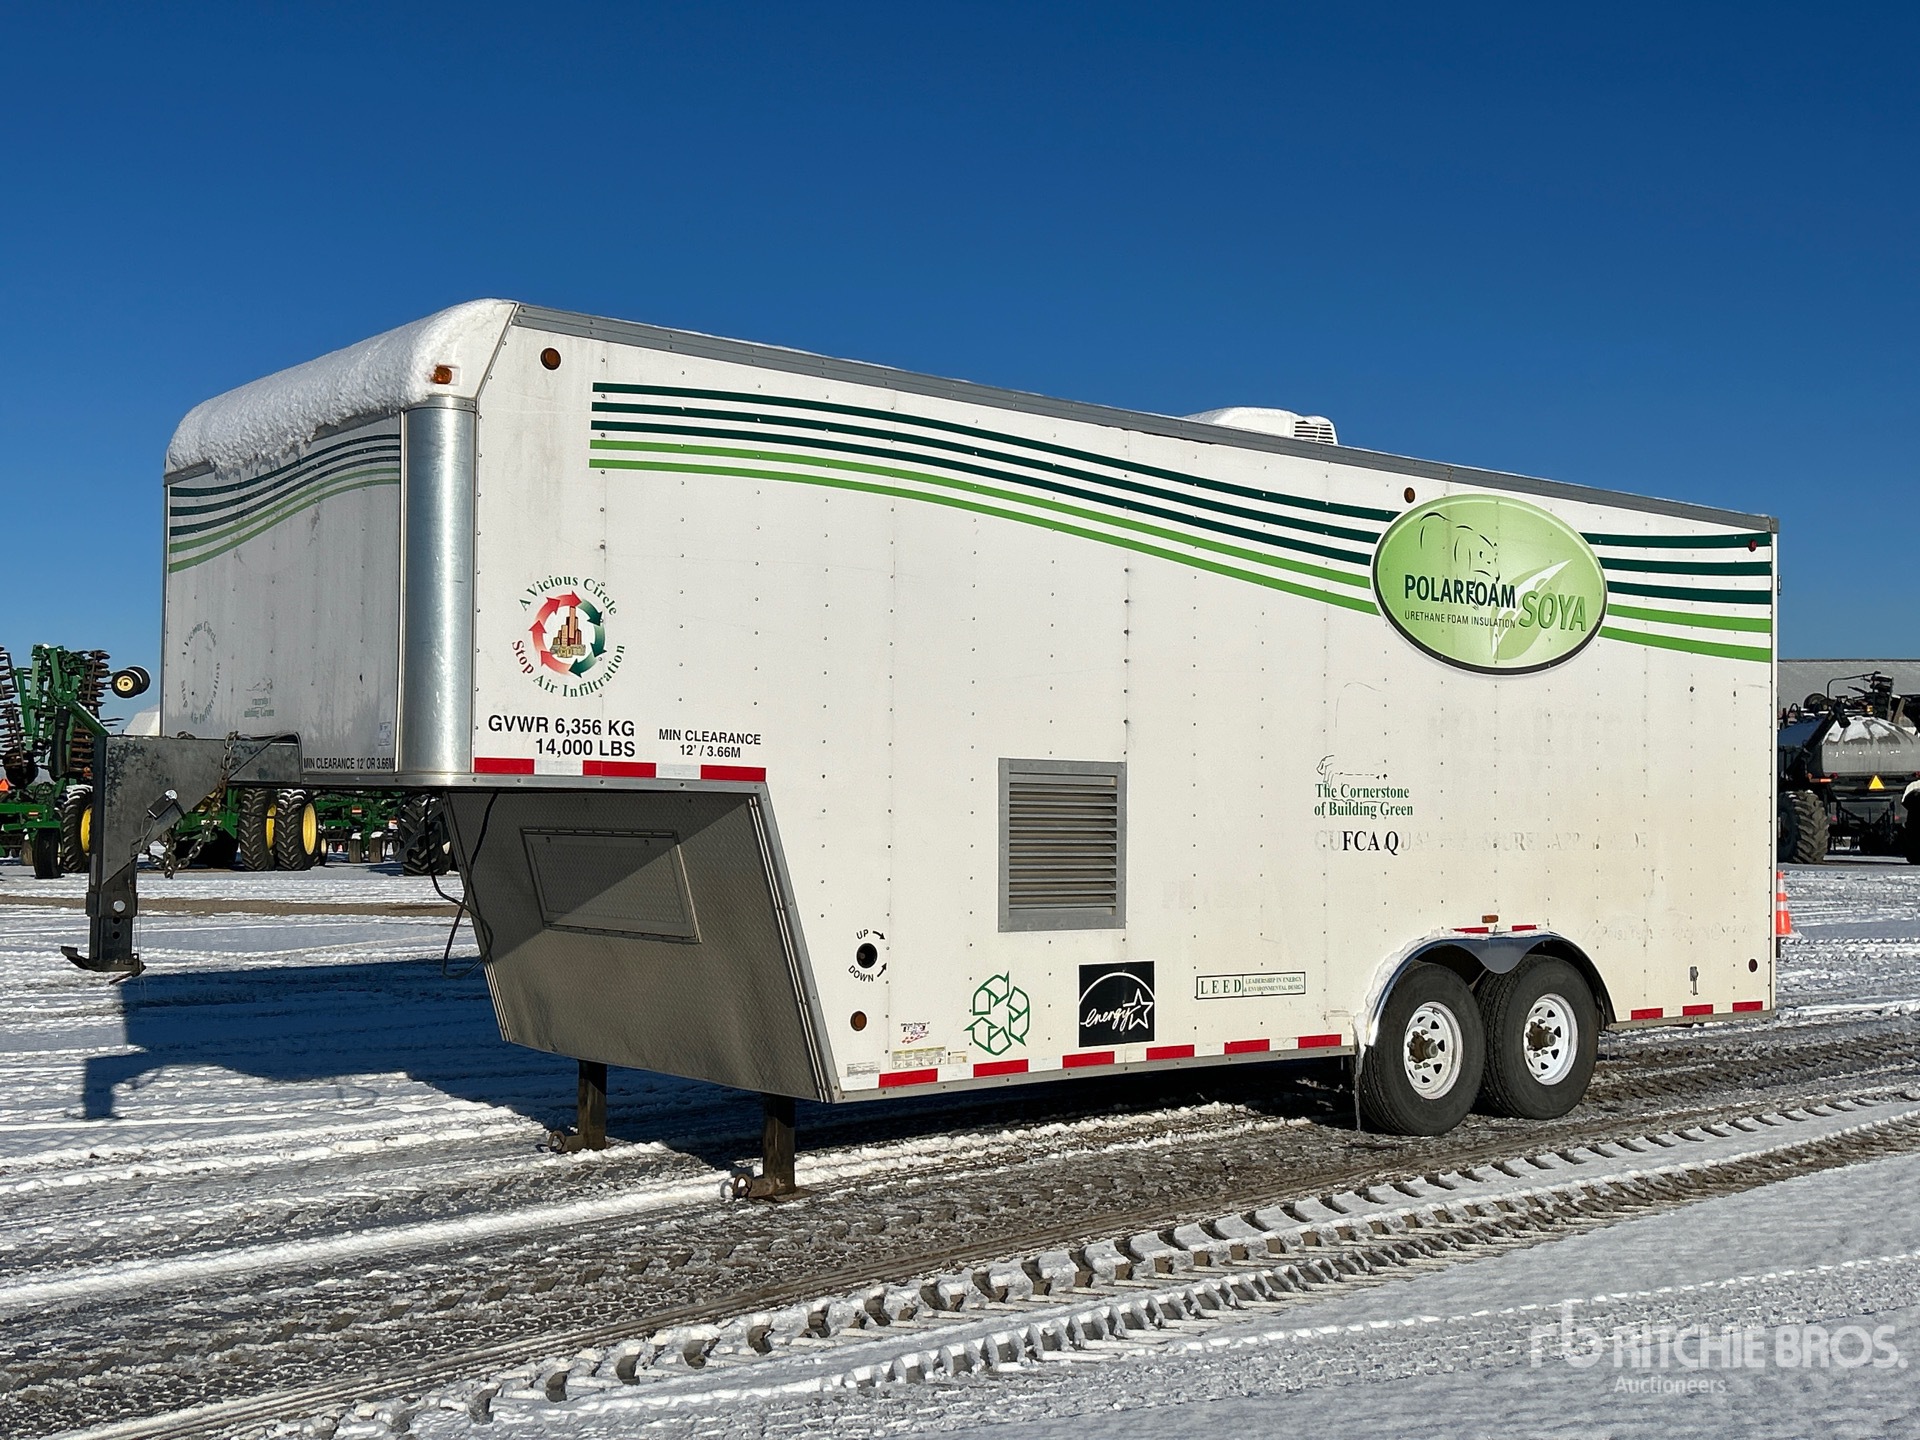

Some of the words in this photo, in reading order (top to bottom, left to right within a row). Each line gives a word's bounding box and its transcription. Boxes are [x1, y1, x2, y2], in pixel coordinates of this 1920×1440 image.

[518, 597, 531, 612] A
[526, 575, 579, 598] Vicious
[583, 578, 617, 616] Circle
[1404, 574, 1516, 609] POLARFOAM
[1518, 590, 1587, 632] SOYA
[1404, 610, 1446, 623] URETHANE
[1447, 614, 1469, 626] FOAM
[1471, 616, 1516, 629] INSULATION
[512, 640, 535, 675] Stop
[533, 675, 558, 695] Air
[563, 644, 626, 698] Infiltration
[488, 714, 549, 733] GVWR
[555, 718, 602, 737] 6,356
[608, 720, 635, 737] KG
[658, 728, 682, 742] MIN
[685, 730, 762, 746] CLEARANCE
[535, 738, 593, 759] 14,000
[600, 740, 636, 758] LBS
[707, 746, 741, 759] 3.66M
[304, 757, 314, 769] MIN
[315, 757, 355, 770] CLEARANCE
[366, 757, 376, 770] OR
[1315, 784, 1338, 799] The
[1340, 783, 1410, 799] Cornerstone
[1314, 801, 1327, 816] of
[1329, 801, 1377, 819] Building
[1379, 801, 1414, 816] Green
[856, 929, 869, 940] UP
[848, 965, 874, 982] DOWN
[1245, 977, 1276, 985] LEADERSHIP
[1200, 979, 1242, 995] LEED
[1248, 984, 1288, 992] ENVIRONMENTAL
[1080, 1007, 1132, 1032] energy
